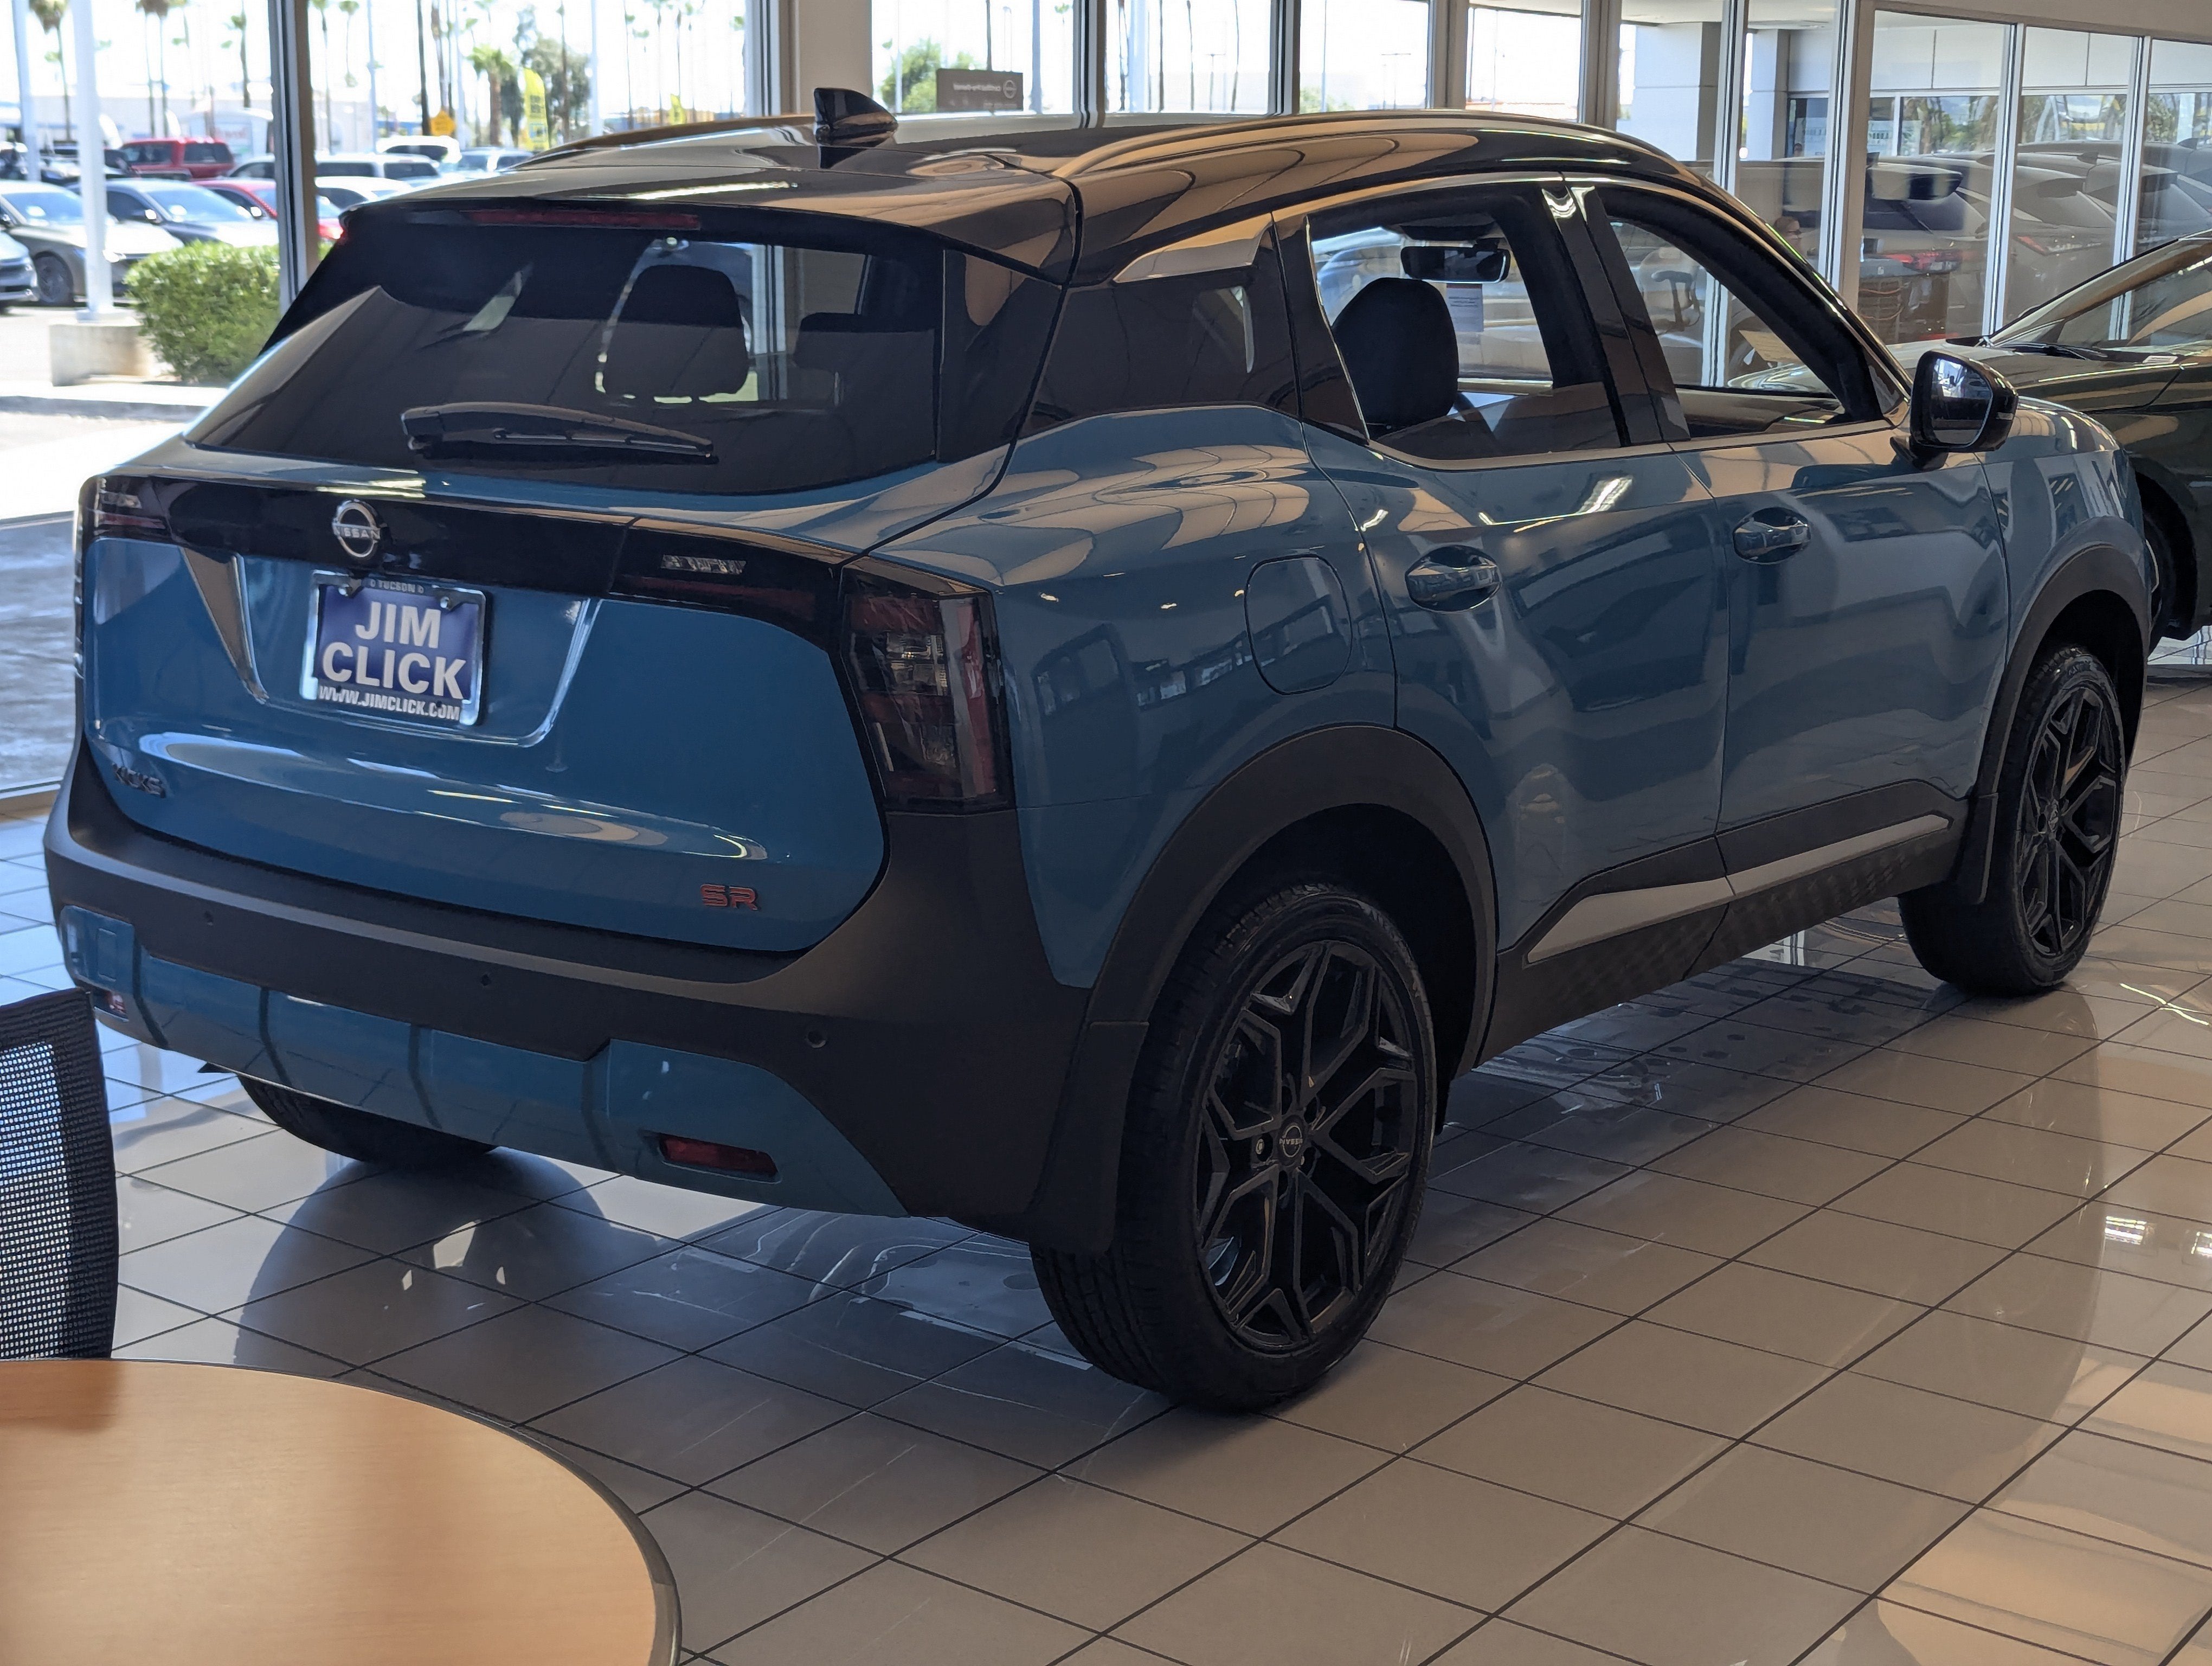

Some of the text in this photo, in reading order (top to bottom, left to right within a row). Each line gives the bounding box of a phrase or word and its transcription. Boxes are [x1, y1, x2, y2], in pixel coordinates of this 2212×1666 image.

[332, 524, 380, 540] NISSAN
[377, 579, 416, 593] TUCSON
[355, 601, 441, 649] JIM
[323, 642, 466, 700] CLICK
[319, 685, 460, 721] WWW.JIMCLICK.COM
[700, 883, 758, 911] SR
